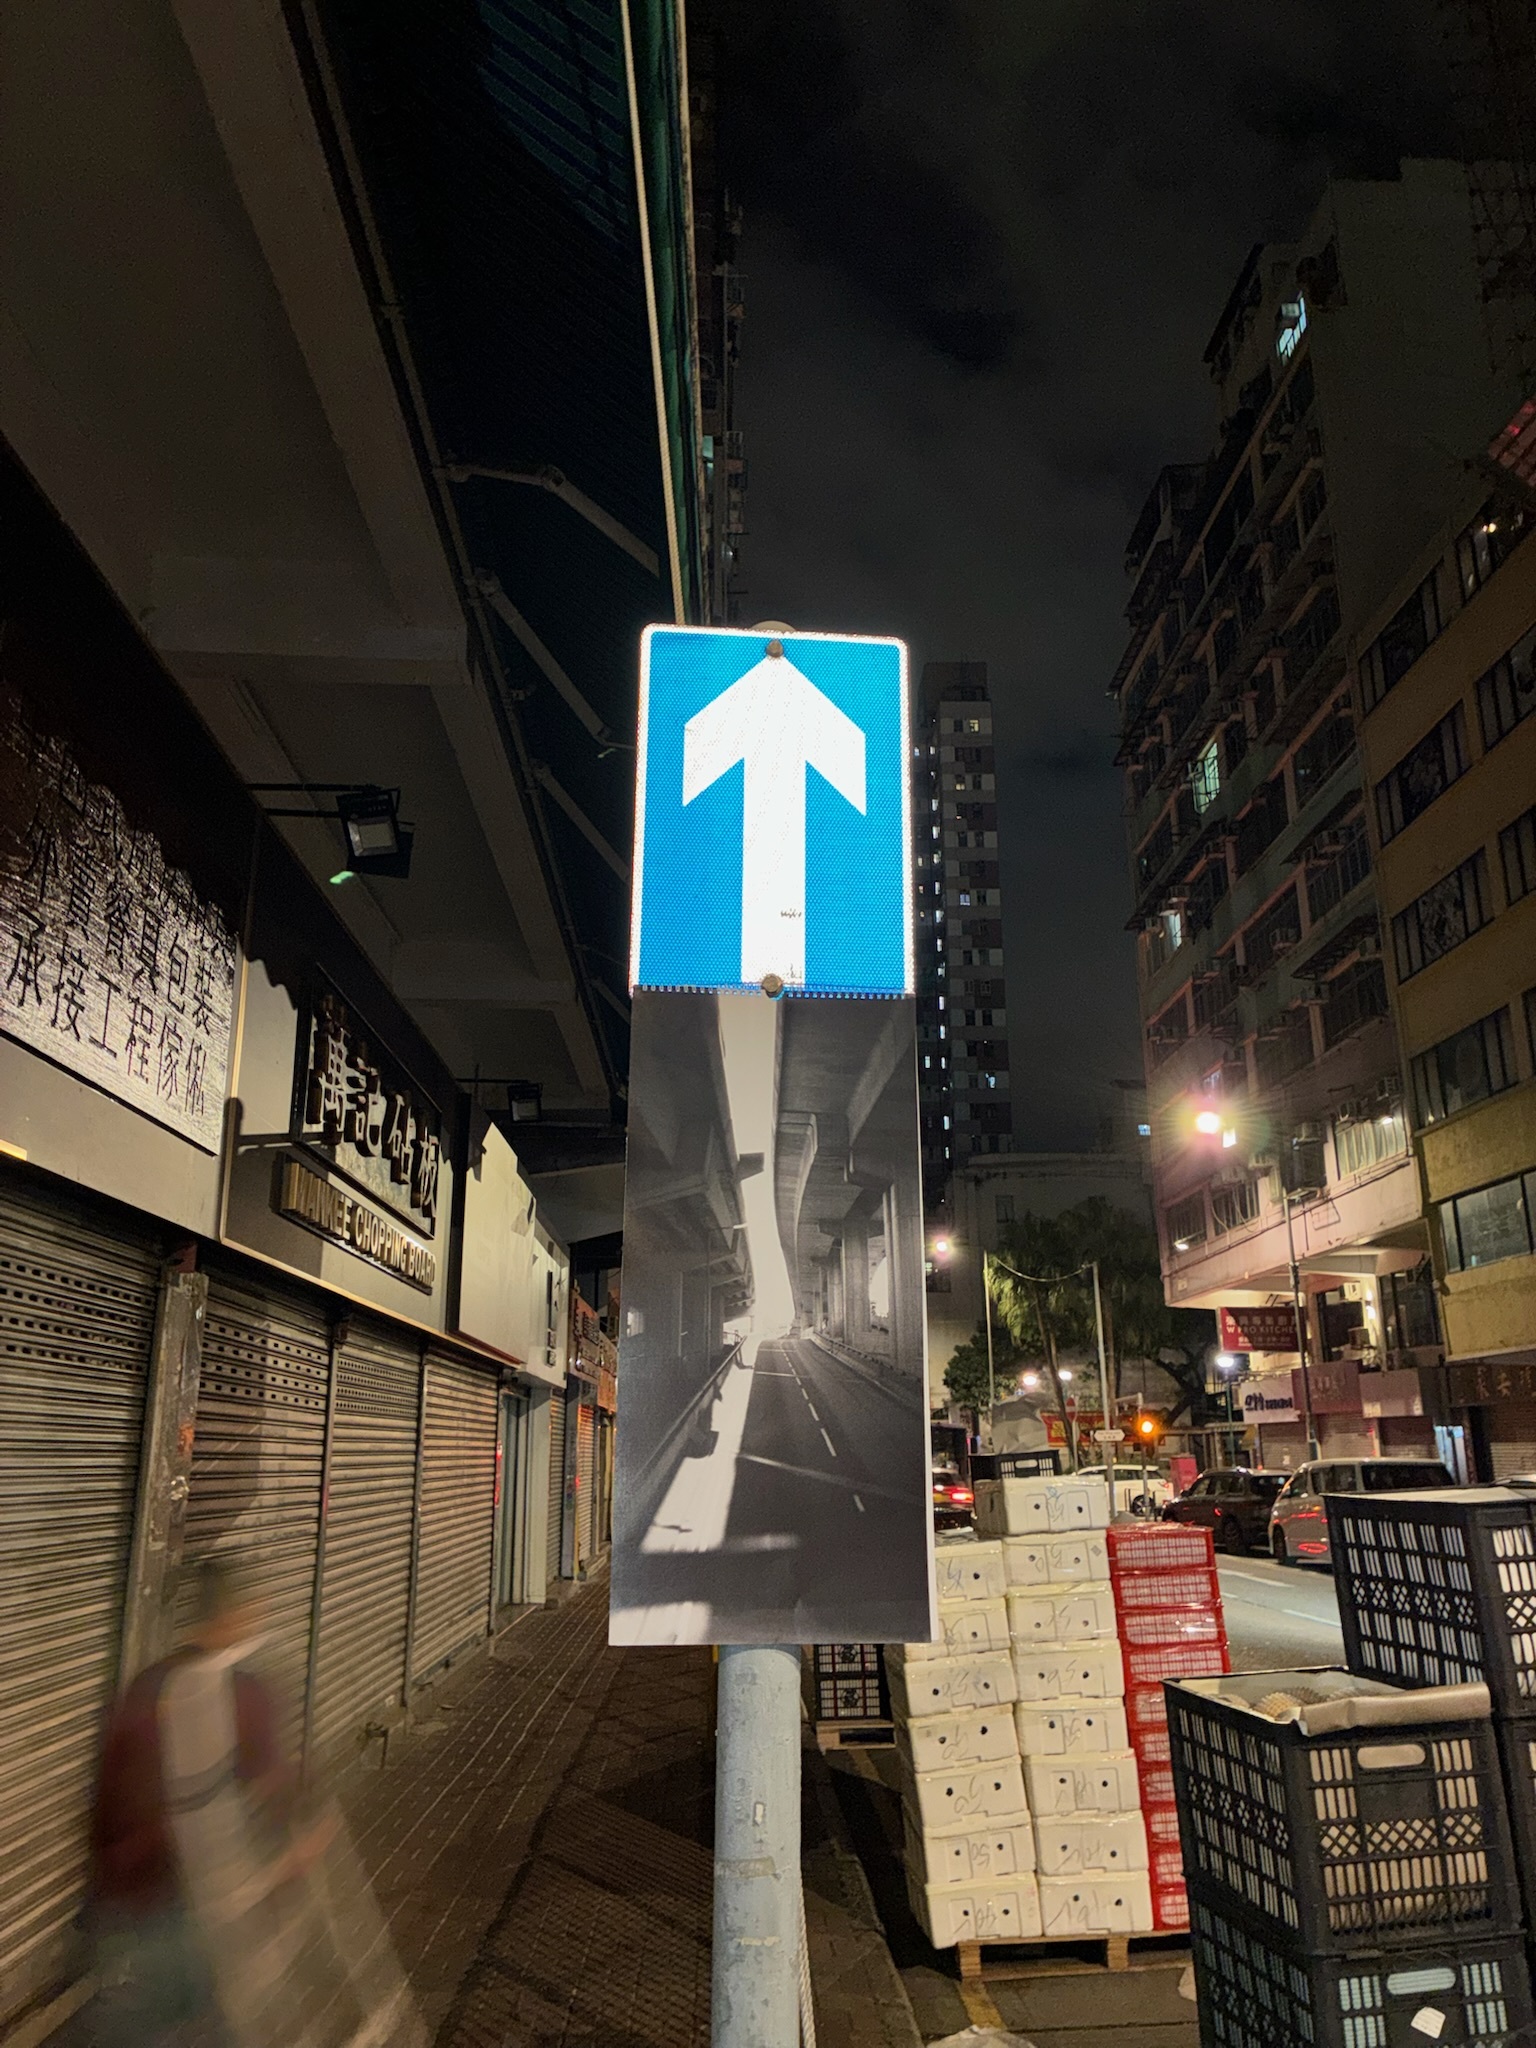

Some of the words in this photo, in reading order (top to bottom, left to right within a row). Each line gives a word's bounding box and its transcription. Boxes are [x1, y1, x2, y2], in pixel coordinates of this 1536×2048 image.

[26, 805, 226, 1036] 外賣餐具包裝
[6, 906, 207, 1117] 承接工程傢俬
[355, 1206, 407, 1272] CHOPPING
[409, 1241, 436, 1286] BOARD
[1238, 1326, 1257, 1335] PRO
[1259, 1326, 1296, 1335] KITCHE
